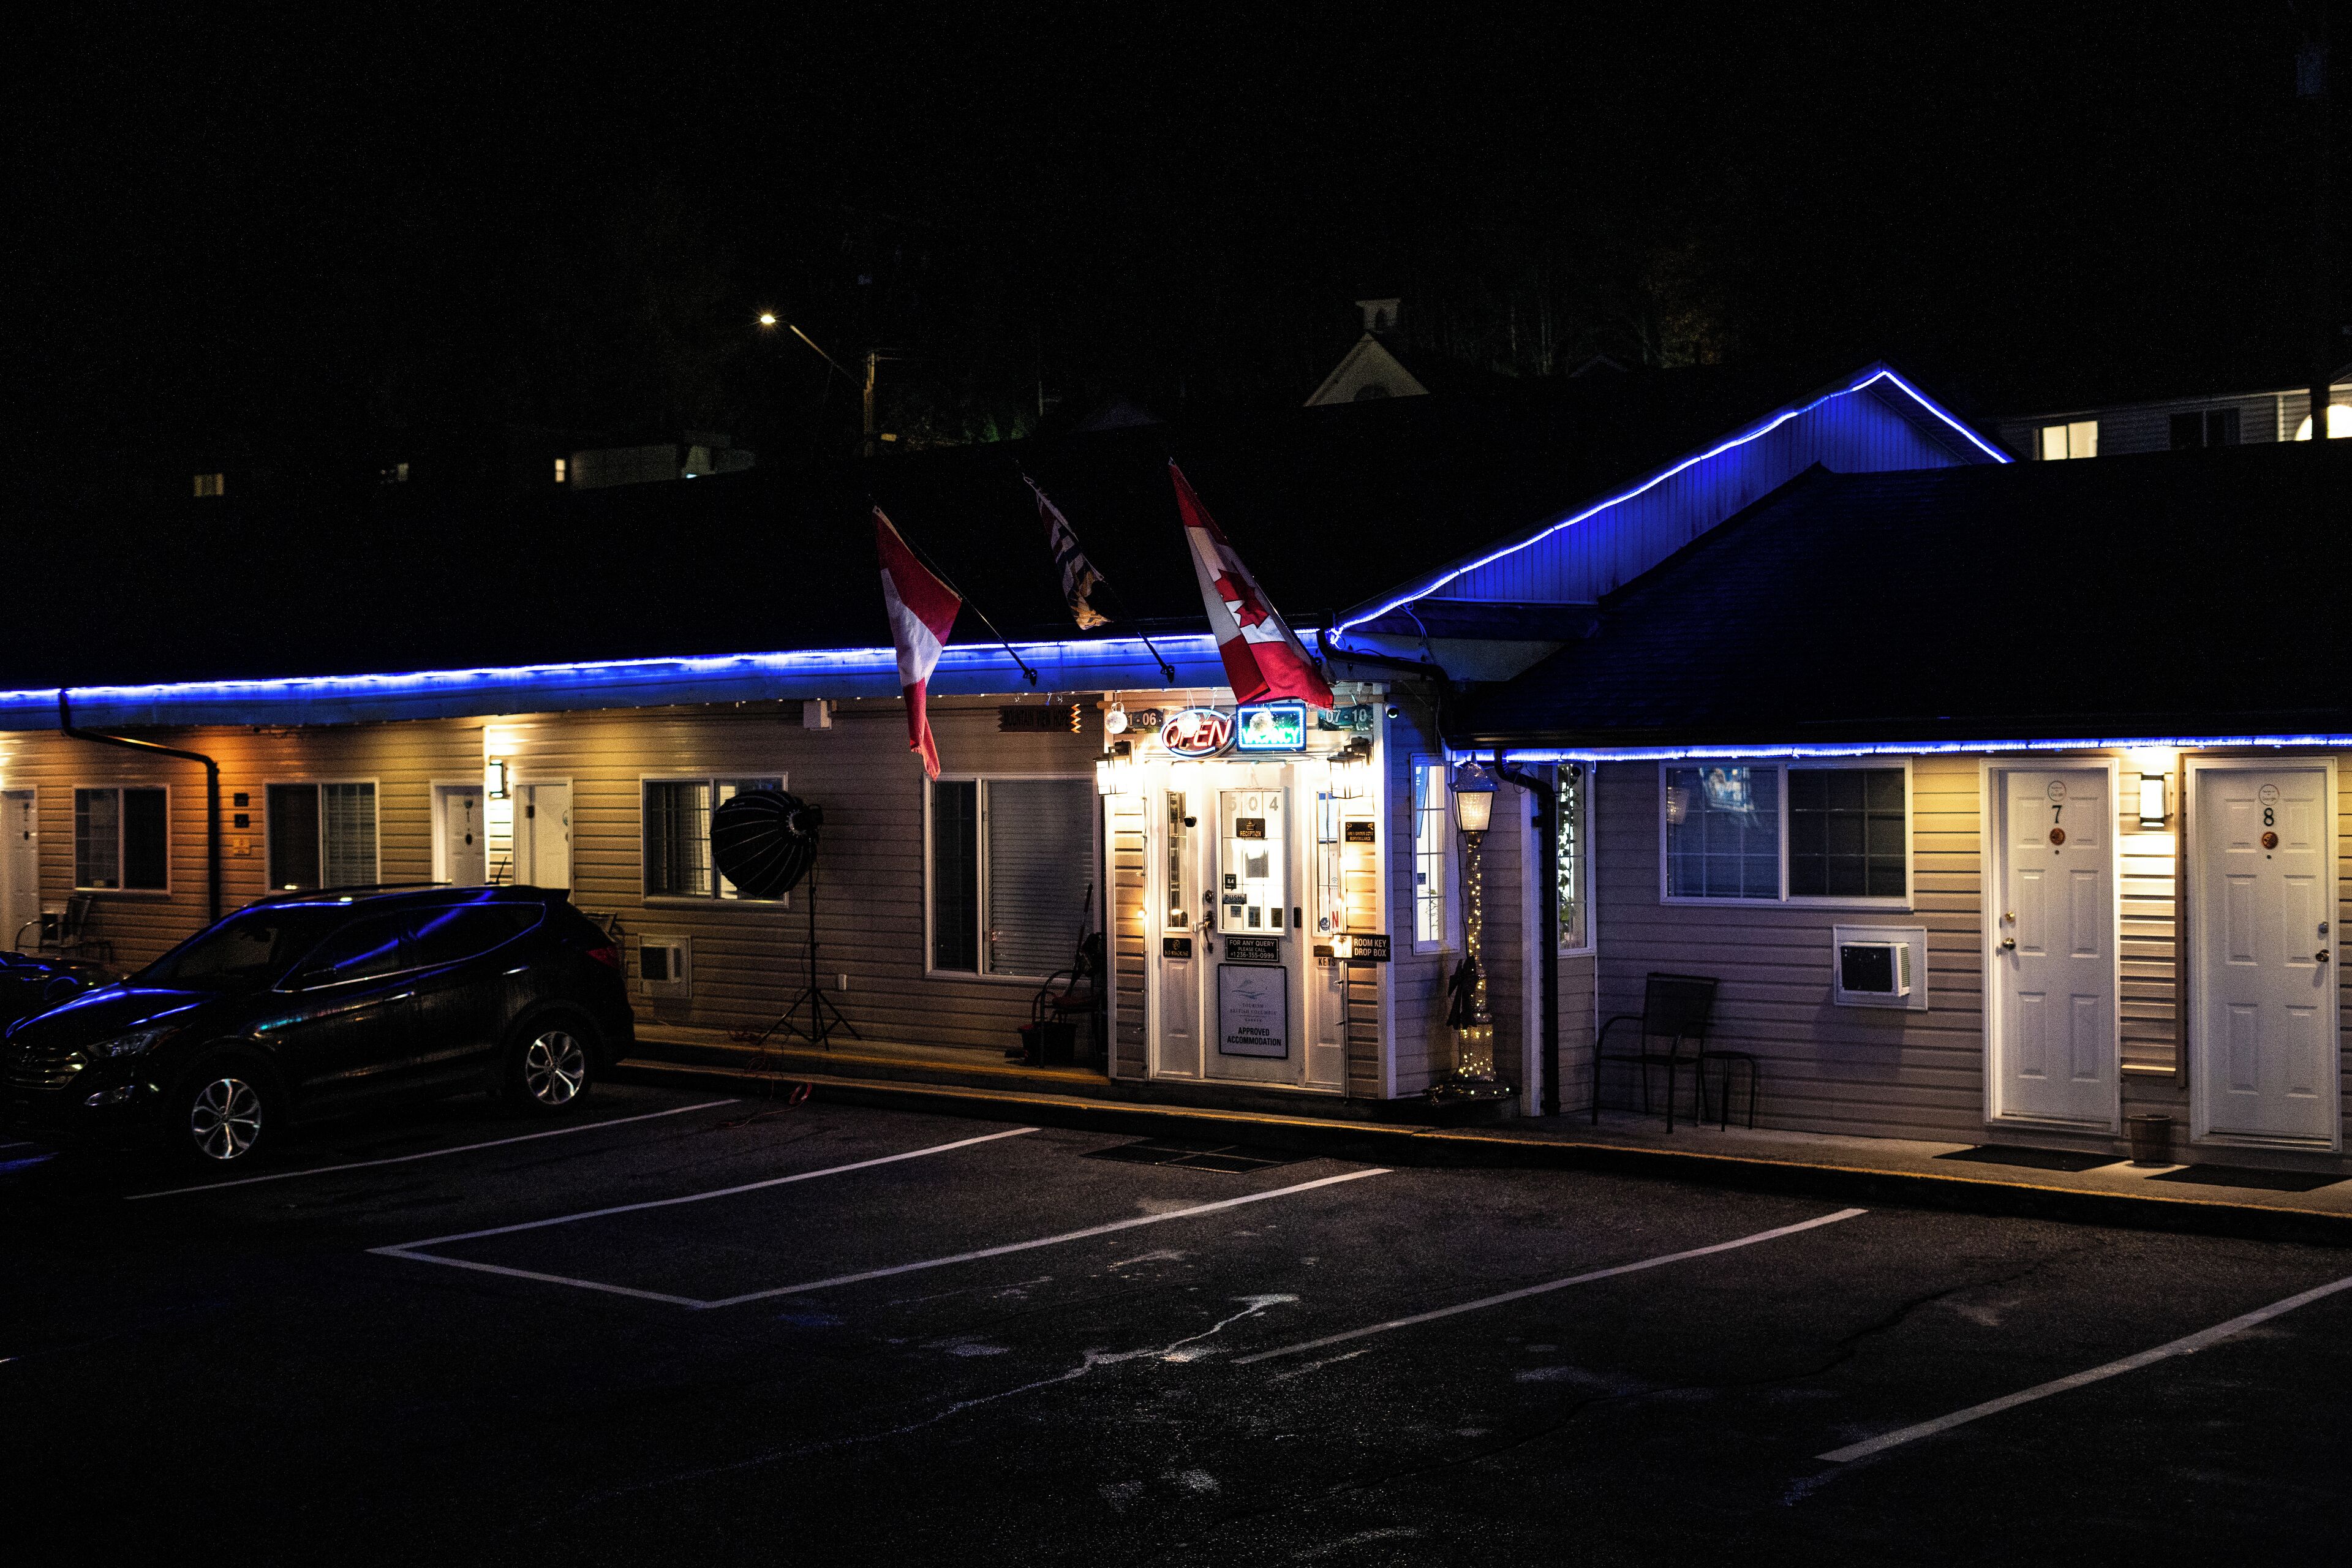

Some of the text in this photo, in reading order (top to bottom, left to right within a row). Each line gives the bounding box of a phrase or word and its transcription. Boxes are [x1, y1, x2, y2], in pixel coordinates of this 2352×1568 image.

[1142, 712, 1156, 726] 06
[1325, 709, 1341, 723] 07
[1352, 708, 1367, 722] 10
[2052, 804, 2062, 824] 7
[2264, 807, 2274, 827] 8
[1354, 938, 1387, 948] ROOM KEY
[1354, 948, 1372, 956] DROP
[1318, 957, 1336, 967] KEYS
[1238, 1027, 1270, 1036] APPROVED
[1227, 1035, 1281, 1046] ACCOMMODATION
